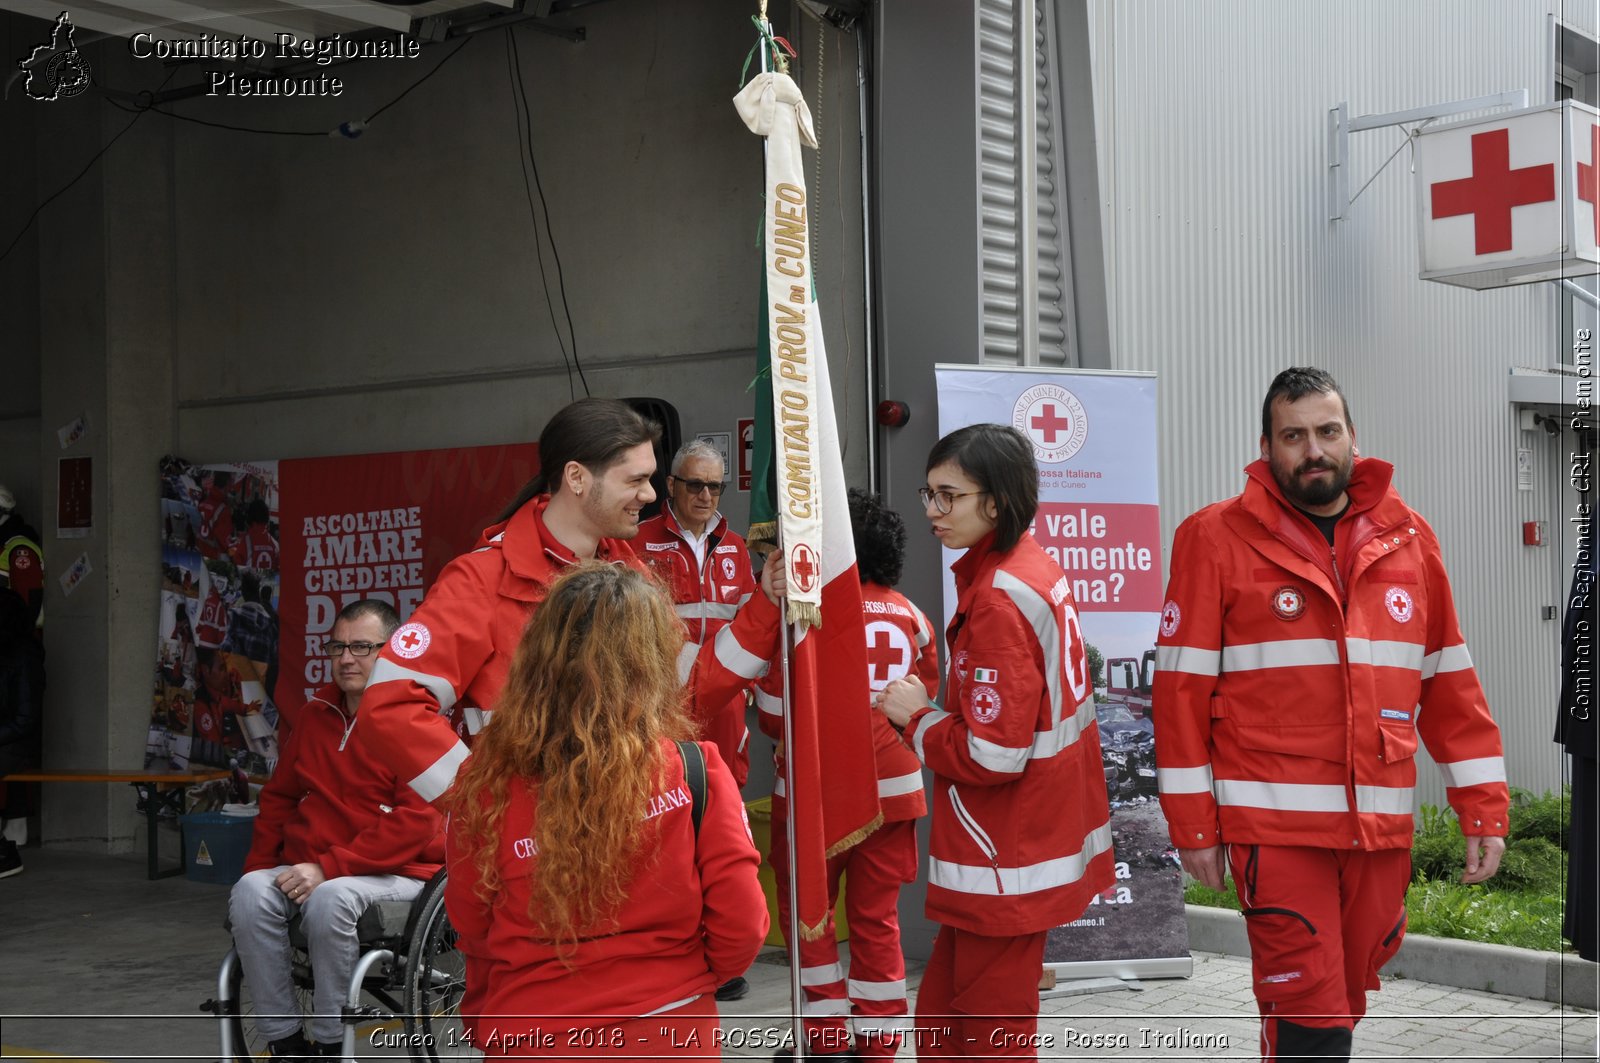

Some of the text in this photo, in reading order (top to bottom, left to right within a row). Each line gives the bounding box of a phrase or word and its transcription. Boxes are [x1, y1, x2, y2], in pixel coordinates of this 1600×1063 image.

[774, 182, 812, 520] COMITATO PROV. DI CUNEO
[1023, 394, 1034, 404] DI
[1033, 387, 1071, 404] GINEVRA
[1070, 402, 1081, 413] 22
[1073, 414, 1086, 448] AGOSTO
[1038, 469, 1102, 479] ossa Italiana
[1061, 481, 1086, 489] Cuneo
[303, 507, 421, 536] ASCOLTARE
[1045, 508, 1106, 538] vale
[303, 528, 423, 568] AMARE
[1041, 542, 1152, 571] amente
[305, 562, 423, 593] CREDERE
[1073, 572, 1125, 603] na?
[864, 601, 886, 614] ROSSA
[641, 786, 692, 821] LIANA
